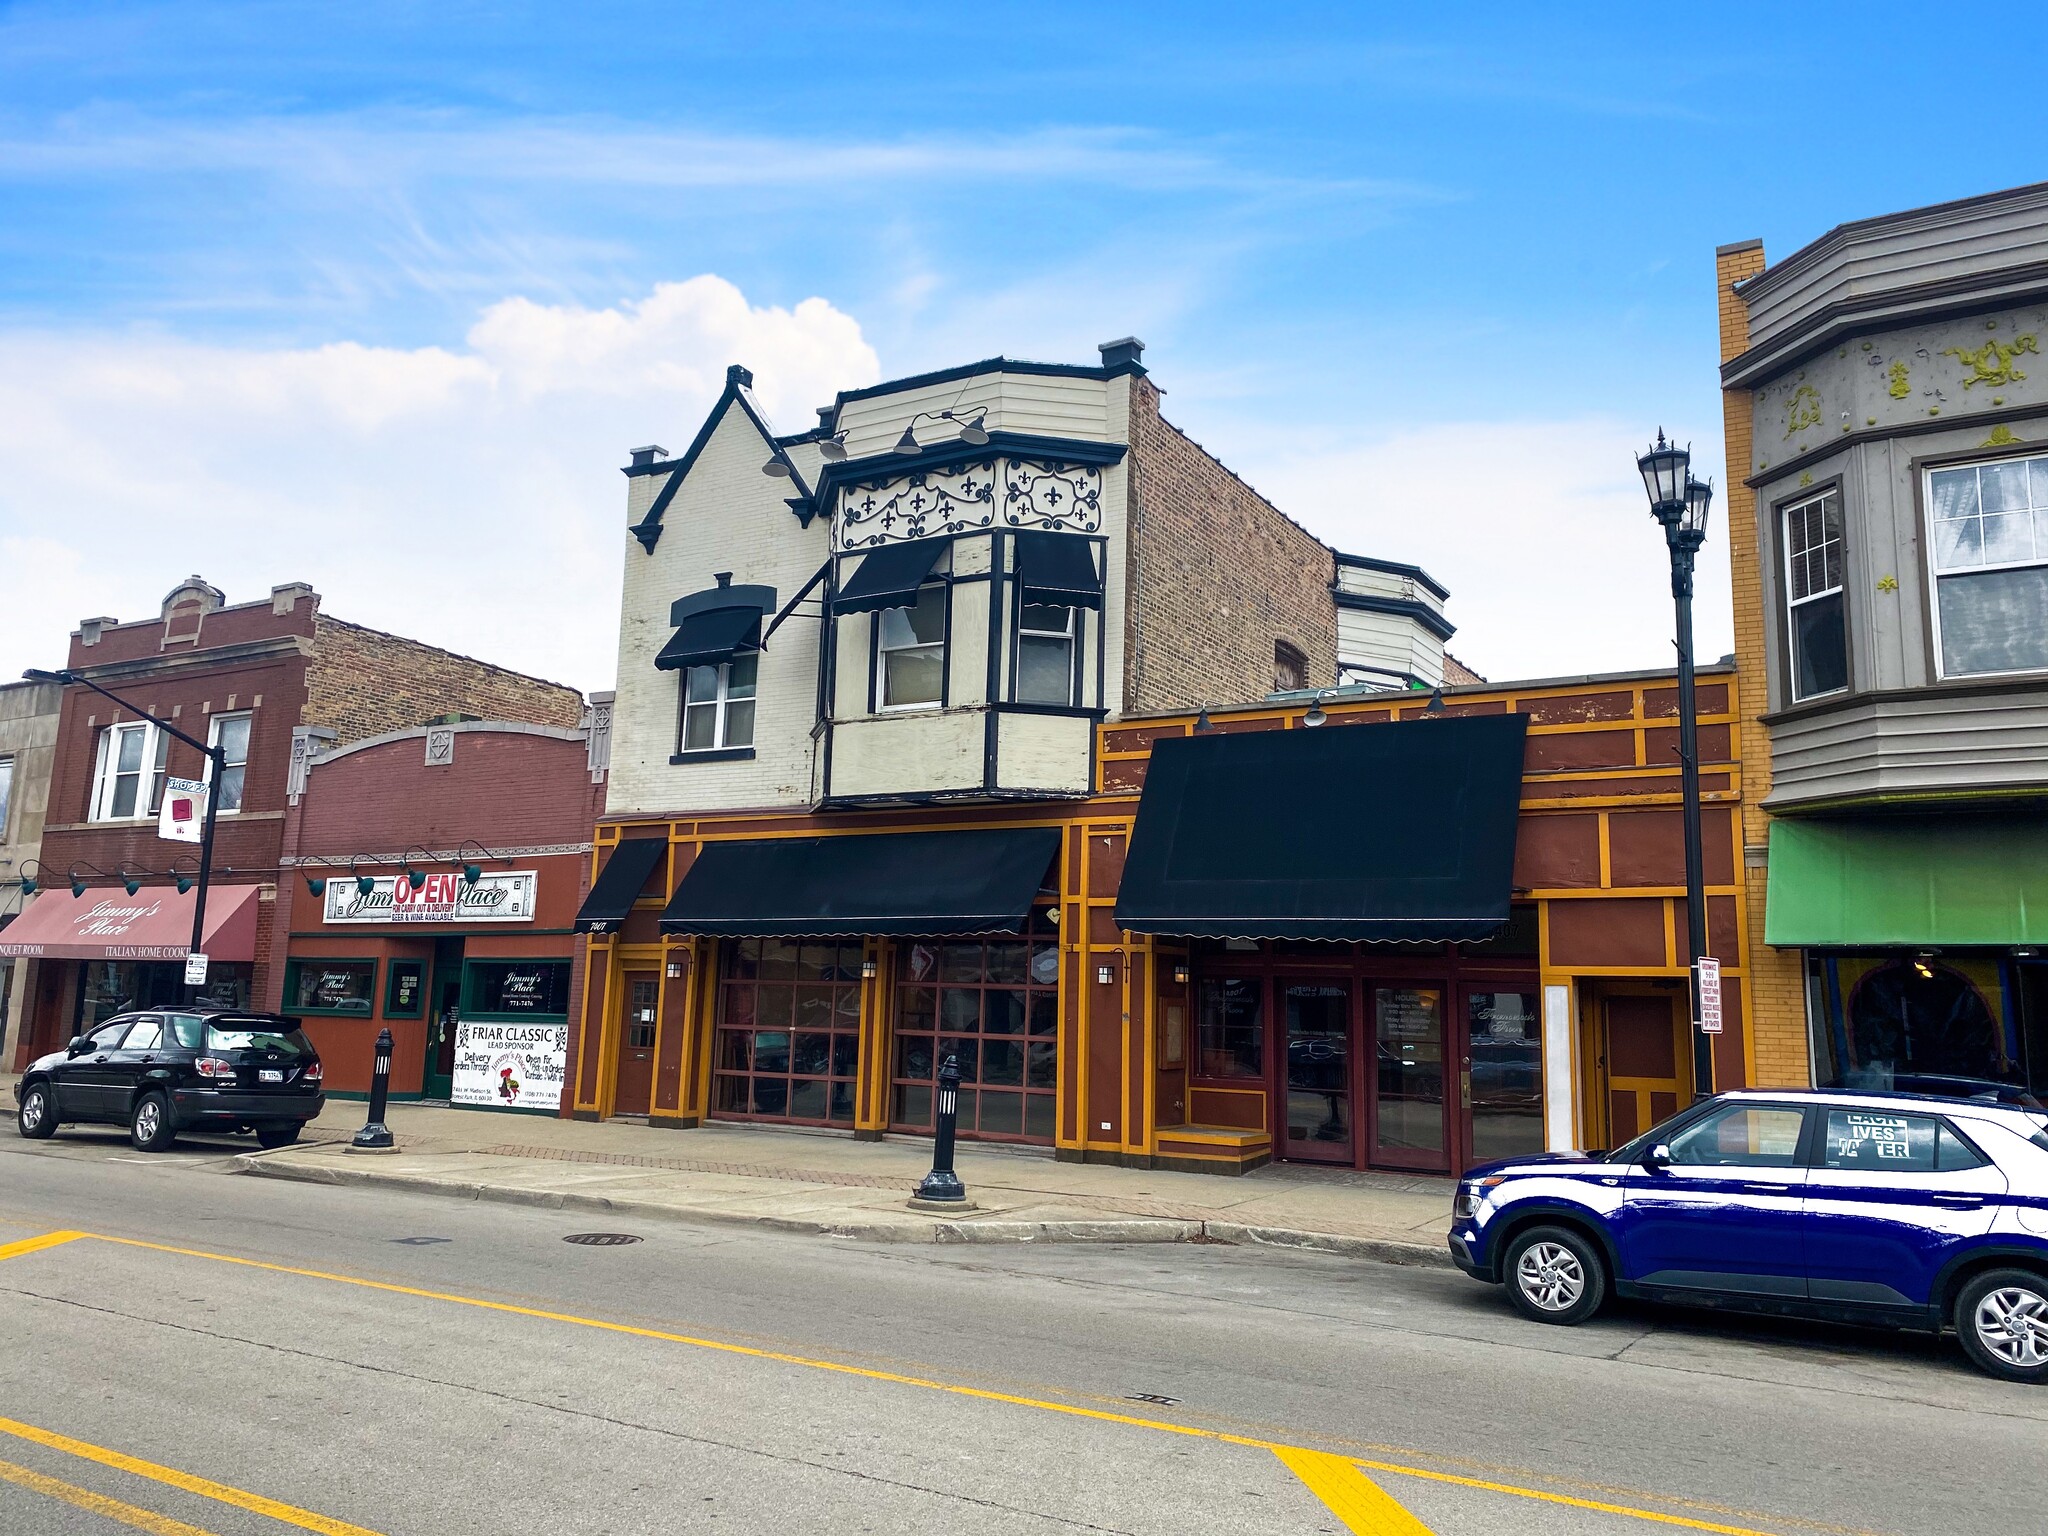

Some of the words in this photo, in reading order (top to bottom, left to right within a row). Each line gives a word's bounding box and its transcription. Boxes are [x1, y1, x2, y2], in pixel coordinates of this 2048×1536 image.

[168, 780, 194, 791] SHOP
[394, 875, 457, 904] OPEN
[74, 899, 161, 924] Jimmy's
[392, 904, 400, 913] FOR
[401, 904, 416, 913] CARRY
[416, 904, 426, 913] OUT
[427, 904, 431, 912] &
[431, 904, 455, 913] DELIVERY
[392, 913, 404, 921] BEER
[405, 913, 409, 921] &
[410, 913, 424, 921] WINE
[425, 913, 454, 921] AVAILABLE
[79, 917, 129, 936] Place
[590, 921, 607, 931] 7407
[23, 945, 44, 955] ROOM
[105, 946, 135, 958] ITALIAN
[137, 946, 162, 958] HOME
[320, 970, 351, 983] Jimmy's
[503, 972, 541, 986] Jimmy's
[325, 980, 345, 989] Place
[511, 982, 536, 993] Place
[472, 1026, 503, 1040] FRIAR
[505, 1028, 553, 1042] CLASSIC
[487, 1041, 503, 1049] LEAD
[504, 1042, 534, 1050] SPONSOR
[464, 1052, 491, 1063] Delivery
[491, 1050, 515, 1070] Jimmy's
[526, 1054, 542, 1066] Open
[543, 1055, 552, 1064] For
[470, 1062, 489, 1076] Through
